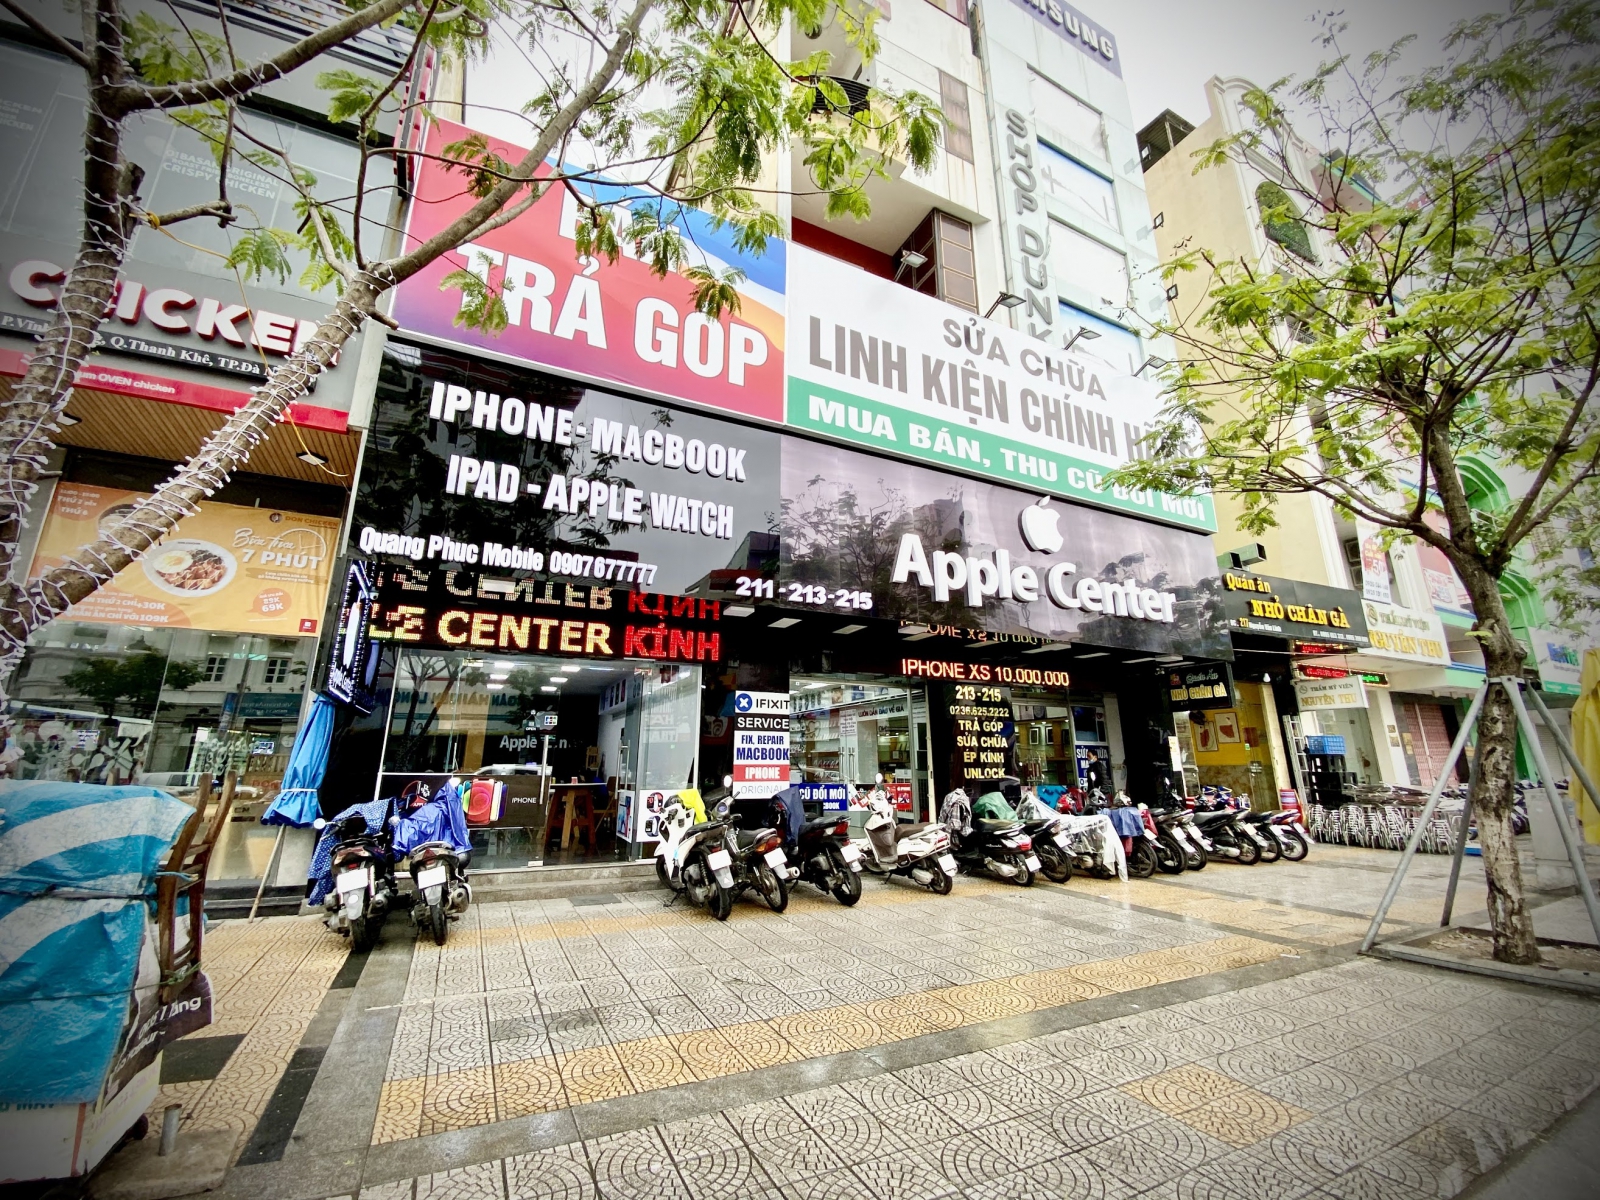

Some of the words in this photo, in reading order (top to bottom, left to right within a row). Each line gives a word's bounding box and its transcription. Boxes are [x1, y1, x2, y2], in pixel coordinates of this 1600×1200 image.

[162, 161, 213, 182] CRISPY
[1006, 107, 1038, 215] SHOP
[456, 254, 607, 350] TRẢ
[8, 259, 340, 368] CICKE
[943, 318, 1011, 367] SỬA
[1019, 347, 1108, 402] CHỮA
[98, 373, 132, 387] OVEN
[133, 377, 176, 394] chicken
[809, 315, 908, 394] LINH
[921, 358, 1010, 425] KIỆN
[1019, 386, 1118, 457] CHÍNH
[808, 394, 898, 443] MUA
[908, 421, 992, 469] BÁN,
[1000, 447, 1059, 483] THU
[445, 453, 521, 504] IPAD
[542, 473, 643, 525] APPLE
[650, 491, 734, 540] WATCH
[242, 548, 256, 563] 7
[260, 550, 323, 570] PHÚT
[359, 526, 424, 560] Quang
[428, 533, 478, 564] Phuc
[482, 541, 544, 572] Mobile
[548, 550, 658, 586] 0907677777
[735, 576, 774, 598] 211
[890, 532, 1040, 607] Apple
[1047, 561, 1177, 623] Center
[1225, 572, 1255, 592] Quán
[1257, 577, 1272, 594] ăn
[261, 603, 284, 613] 69K
[1250, 596, 1285, 620] NHỎ
[1287, 603, 1328, 625] CHÂN
[1329, 606, 1351, 629] GÀ
[437, 608, 614, 656] CENTER
[1420, 638, 1443, 658] THU
[902, 658, 965, 680] IPHONE
[969, 663, 991, 682] XS
[995, 667, 1070, 687] 10.000.000
[955, 685, 976, 700] 213
[982, 687, 1002, 702] 215
[1213, 682, 1228, 698] GÀ
[1338, 693, 1357, 704] THU
[755, 698, 790, 710] IFIXIT
[737, 716, 790, 730] SERVICE
[958, 717, 981, 732] TRẢ
[983, 717, 1004, 732] GÓP
[499, 735, 538, 752] Apple
[741, 734, 755, 745] FIX,
[757, 735, 785, 746] REPAIR
[956, 732, 979, 747] SỬA
[980, 734, 1009, 748] CHỮA
[736, 746, 790, 761] MACBOOK
[963, 749, 977, 763] ÉP
[979, 750, 1005, 764] KÍNH
[744, 766, 781, 780] IPHONE
[963, 767, 1006, 779] UNLOCK
[811, 784, 828, 800] ĐỔI
[829, 787, 846, 800] MỚI
